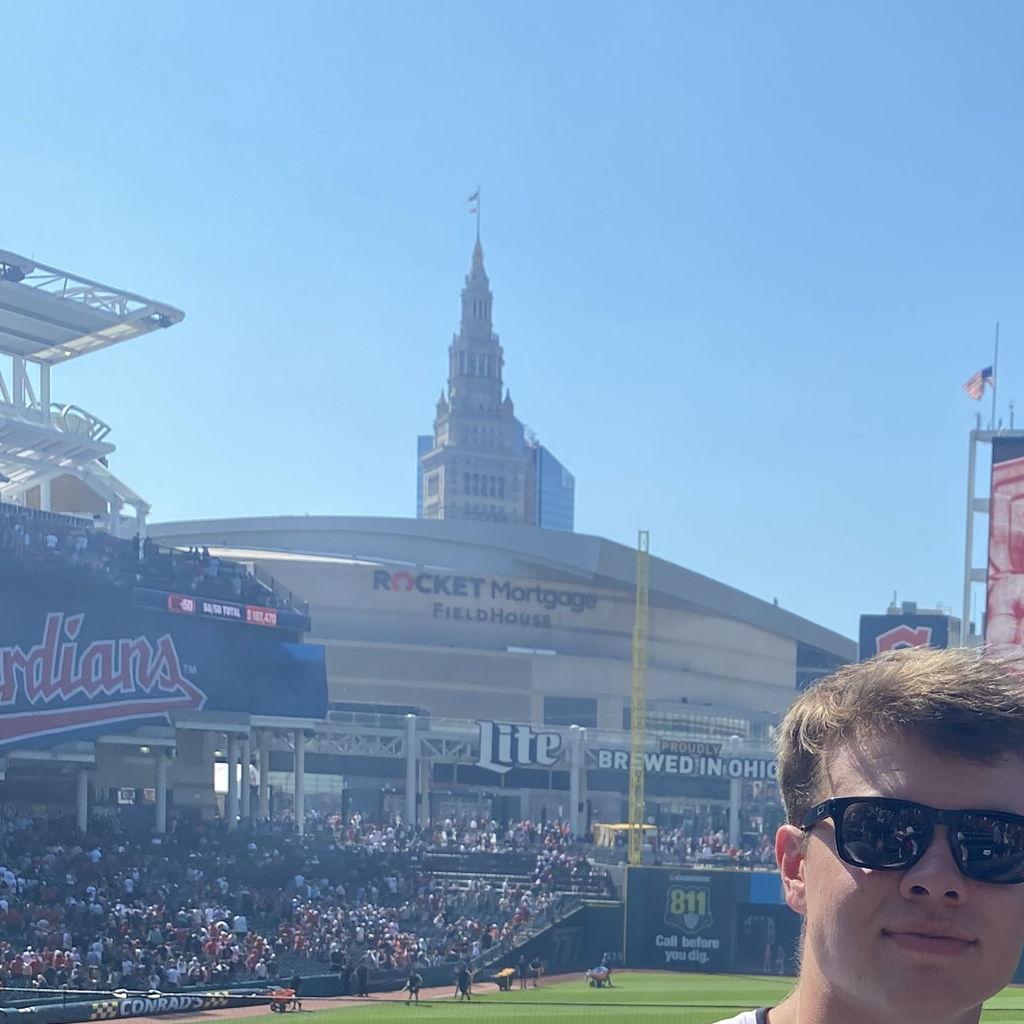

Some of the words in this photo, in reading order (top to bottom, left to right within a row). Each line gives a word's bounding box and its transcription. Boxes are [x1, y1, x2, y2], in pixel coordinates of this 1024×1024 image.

[373, 569, 486, 598] ROCKET
[491, 580, 598, 612] Mortgage
[0, 612, 207, 706] rdians
[474, 719, 562, 774] Lite
[660, 739, 722, 756] PROUDLY
[700, 757, 722, 776] IN
[671, 888, 706, 916] 811
[655, 934, 677, 947] Call
[682, 933, 720, 949] before
[665, 951, 686, 963] you
[688, 950, 710, 964] dig.
[120, 995, 204, 1016] CONRAD'S
